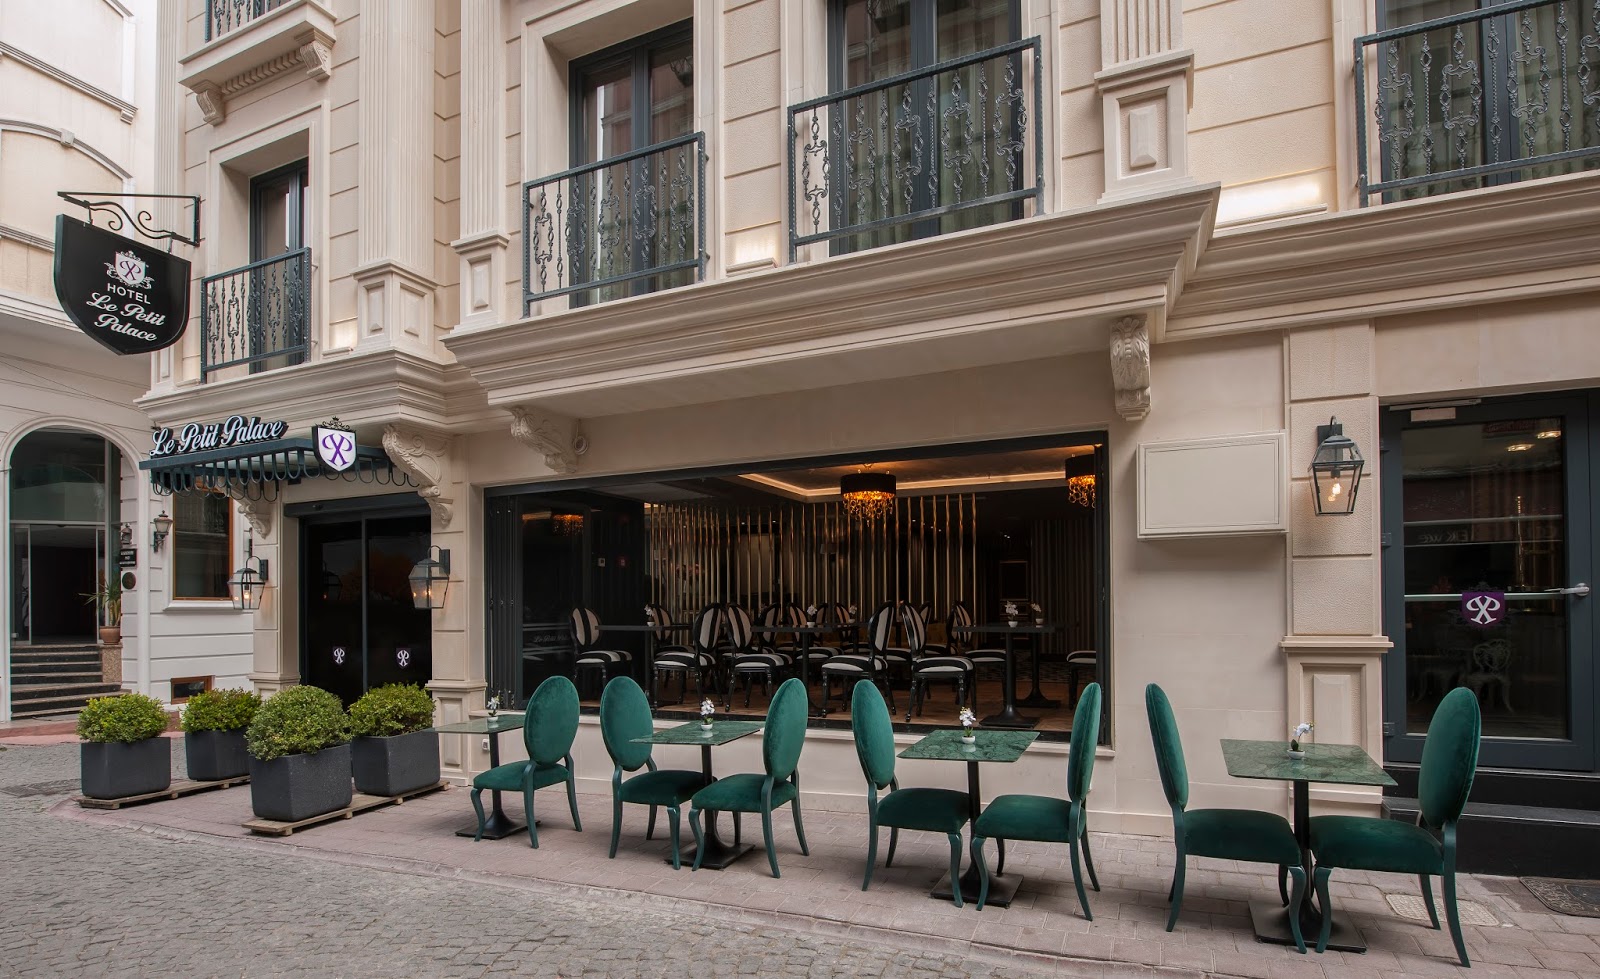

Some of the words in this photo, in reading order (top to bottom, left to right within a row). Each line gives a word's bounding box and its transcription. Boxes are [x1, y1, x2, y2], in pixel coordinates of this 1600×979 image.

[85, 292, 119, 313] Le
[120, 303, 167, 327] Petit
[107, 282, 151, 305] HOTEL
[94, 313, 158, 342] Palace
[149, 426, 176, 457] Le
[177, 422, 219, 453] Petit
[220, 414, 285, 445] Palace
